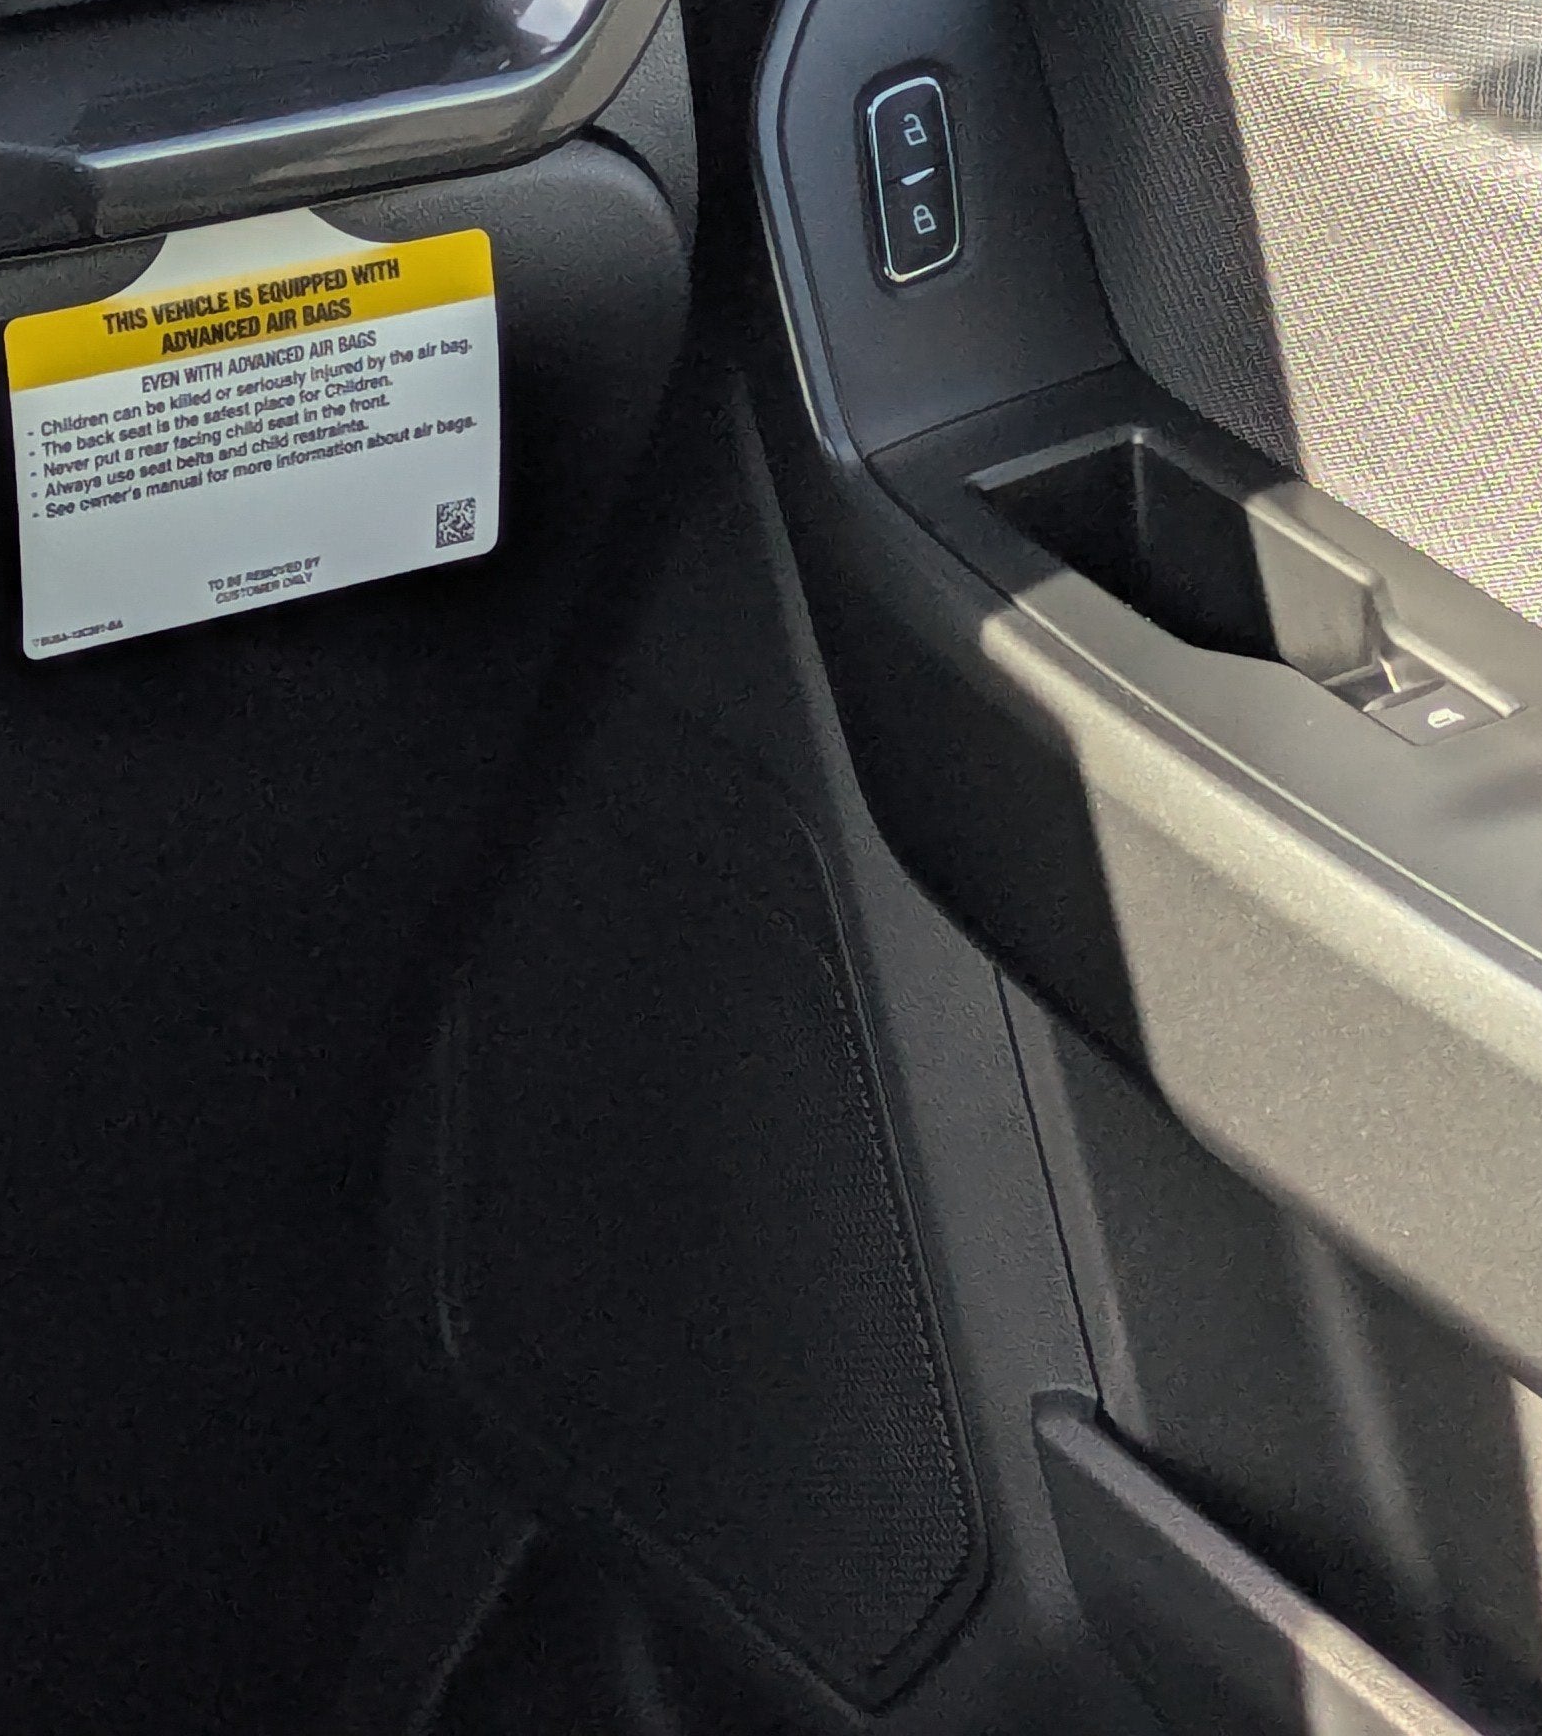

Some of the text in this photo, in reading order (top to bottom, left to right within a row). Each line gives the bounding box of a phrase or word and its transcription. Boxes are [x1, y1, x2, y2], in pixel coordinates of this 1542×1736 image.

[102, 259, 400, 334] THIS VEHICLE IS EQUIPPED WITH
[161, 298, 352, 354] ADVANCED AIR BAGS
[41, 339, 472, 437] Children can be killed or seriously injured by the air bag.
[141, 330, 377, 393] EVEN WITH ADVANCED AIR BAGS
[41, 441, 72, 457] The
[77, 430, 115, 450] back
[118, 422, 153, 442] seat
[174, 414, 199, 430] the
[203, 402, 251, 424] safest
[254, 395, 295, 416] place
[299, 389, 322, 404] for
[324, 376, 393, 398] Children.
[43, 458, 90, 478] Never
[94, 449, 121, 471] put
[138, 441, 169, 458] rear
[172, 430, 221, 450] facing
[225, 418, 265, 439] child
[267, 411, 301, 435] seat
[321, 404, 346, 421] the
[349, 393, 390, 413] front.
[45, 420, 369, 497] Always use seat belts and child restraints.
[45, 502, 76, 518] See
[146, 471, 203, 496] manual
[206, 468, 229, 483] for
[232, 459, 274, 478] more
[276, 440, 363, 468] information
[366, 428, 410, 449] about
[413, 423, 433, 439] air
[437, 417, 477, 434] bags.
